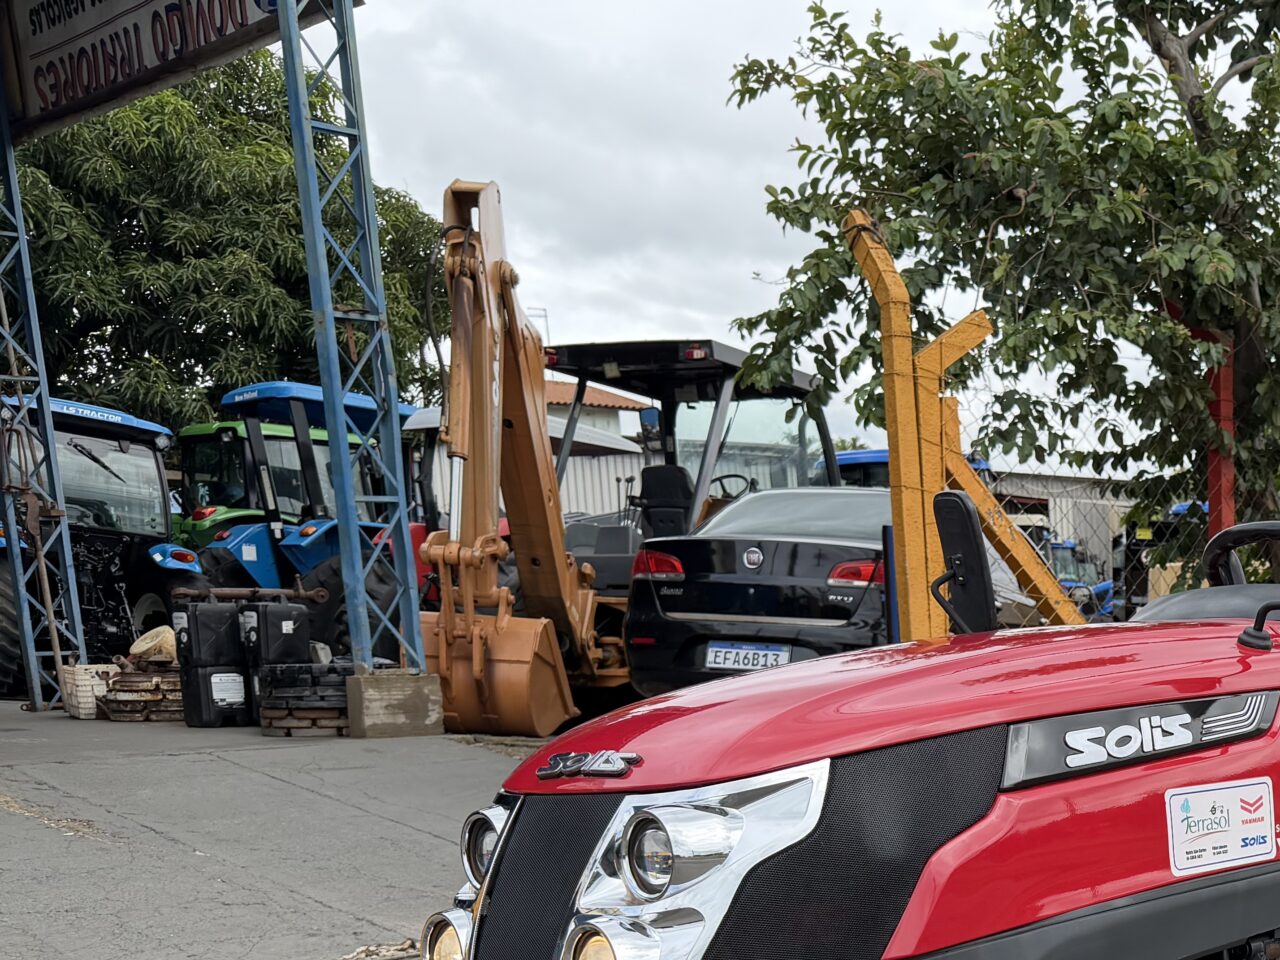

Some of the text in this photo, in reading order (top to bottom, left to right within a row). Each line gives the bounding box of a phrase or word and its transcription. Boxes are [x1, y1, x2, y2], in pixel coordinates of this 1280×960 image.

[33, 22, 149, 113] TRATORES
[63, 405, 122, 423] LS TRACTOR
[713, 650, 780, 668] EFA6B13
[1181, 809, 1231, 835] Terrasol
[1241, 816, 1265, 826] YANMAR
